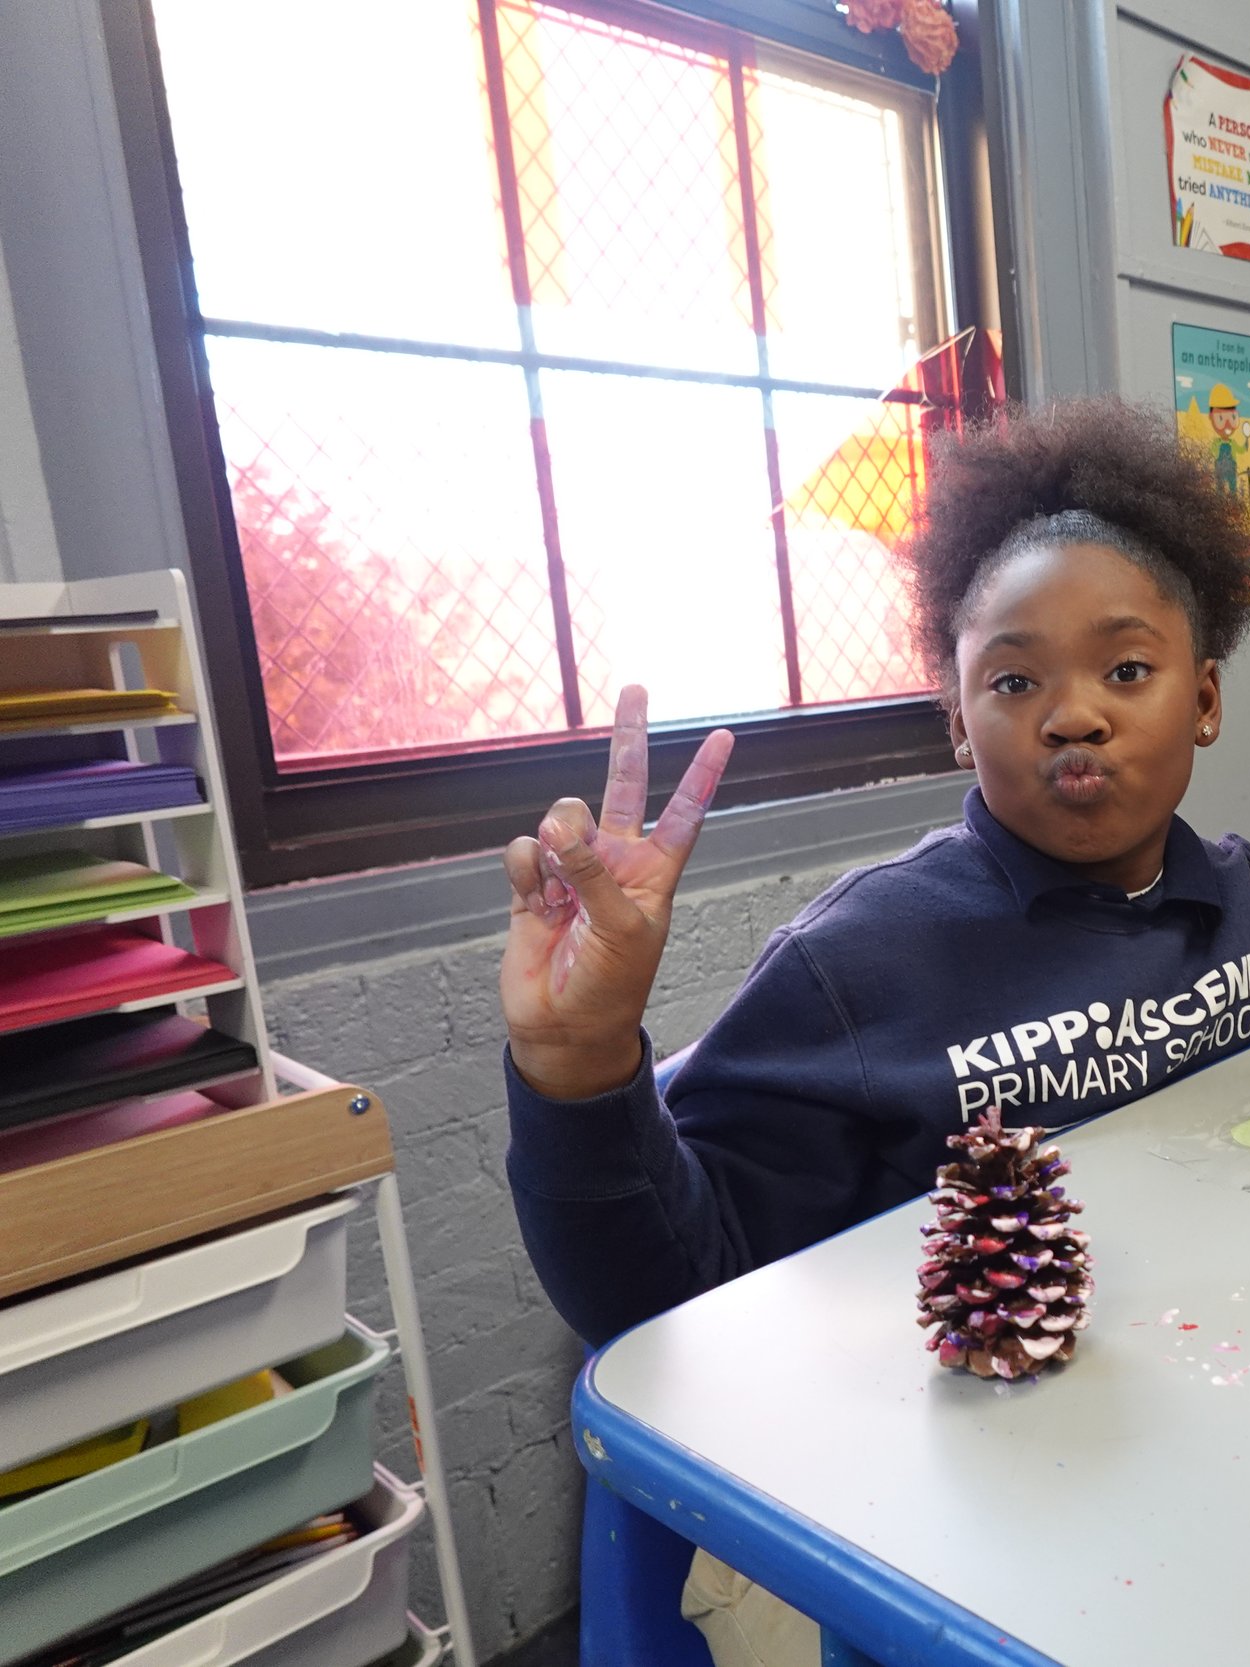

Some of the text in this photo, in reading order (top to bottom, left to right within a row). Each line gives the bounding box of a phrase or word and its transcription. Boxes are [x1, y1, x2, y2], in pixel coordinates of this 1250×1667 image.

[1208, 112, 1216, 127] A
[1182, 130, 1207, 148] who
[1208, 136, 1248, 161] NEVER
[1193, 155, 1244, 183] MISTAKE
[1178, 176, 1206, 195] tried
[1182, 351, 1194, 364] an
[1222, 343, 1234, 353] can
[1237, 345, 1245, 355] be
[957, 1050, 1149, 1123] PRIMARY
